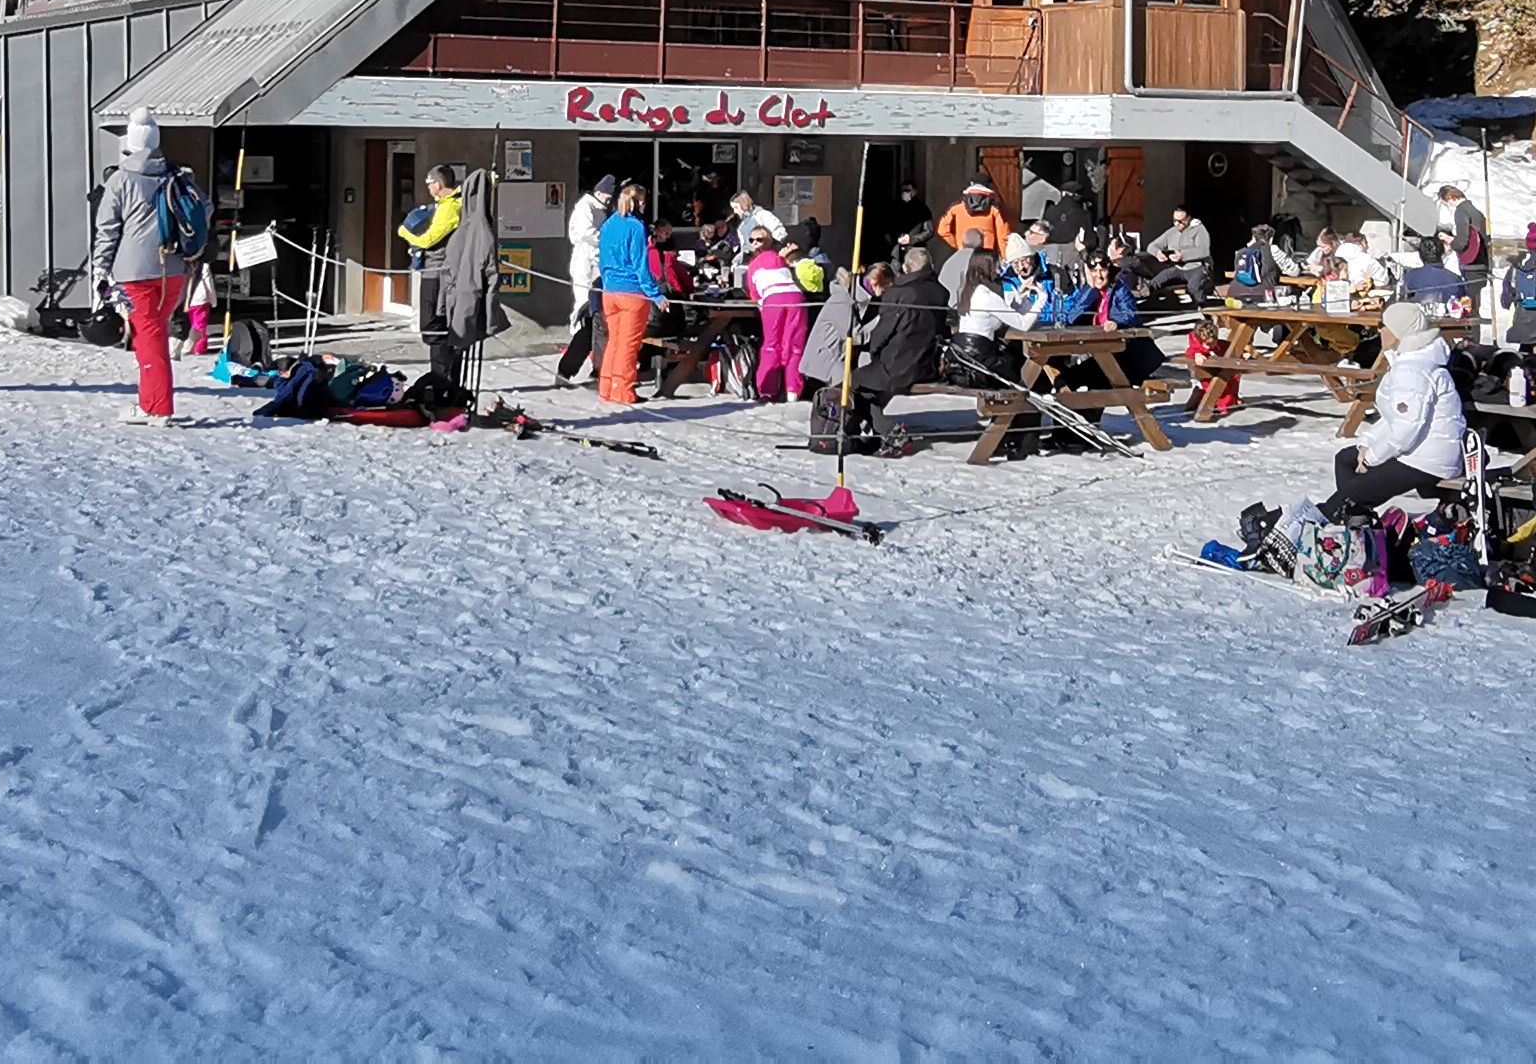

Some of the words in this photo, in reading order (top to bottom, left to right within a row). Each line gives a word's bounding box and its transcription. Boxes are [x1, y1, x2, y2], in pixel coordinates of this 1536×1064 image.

[565, 86, 690, 131] Refuge
[704, 89, 746, 126] du
[758, 92, 838, 129] Clot
